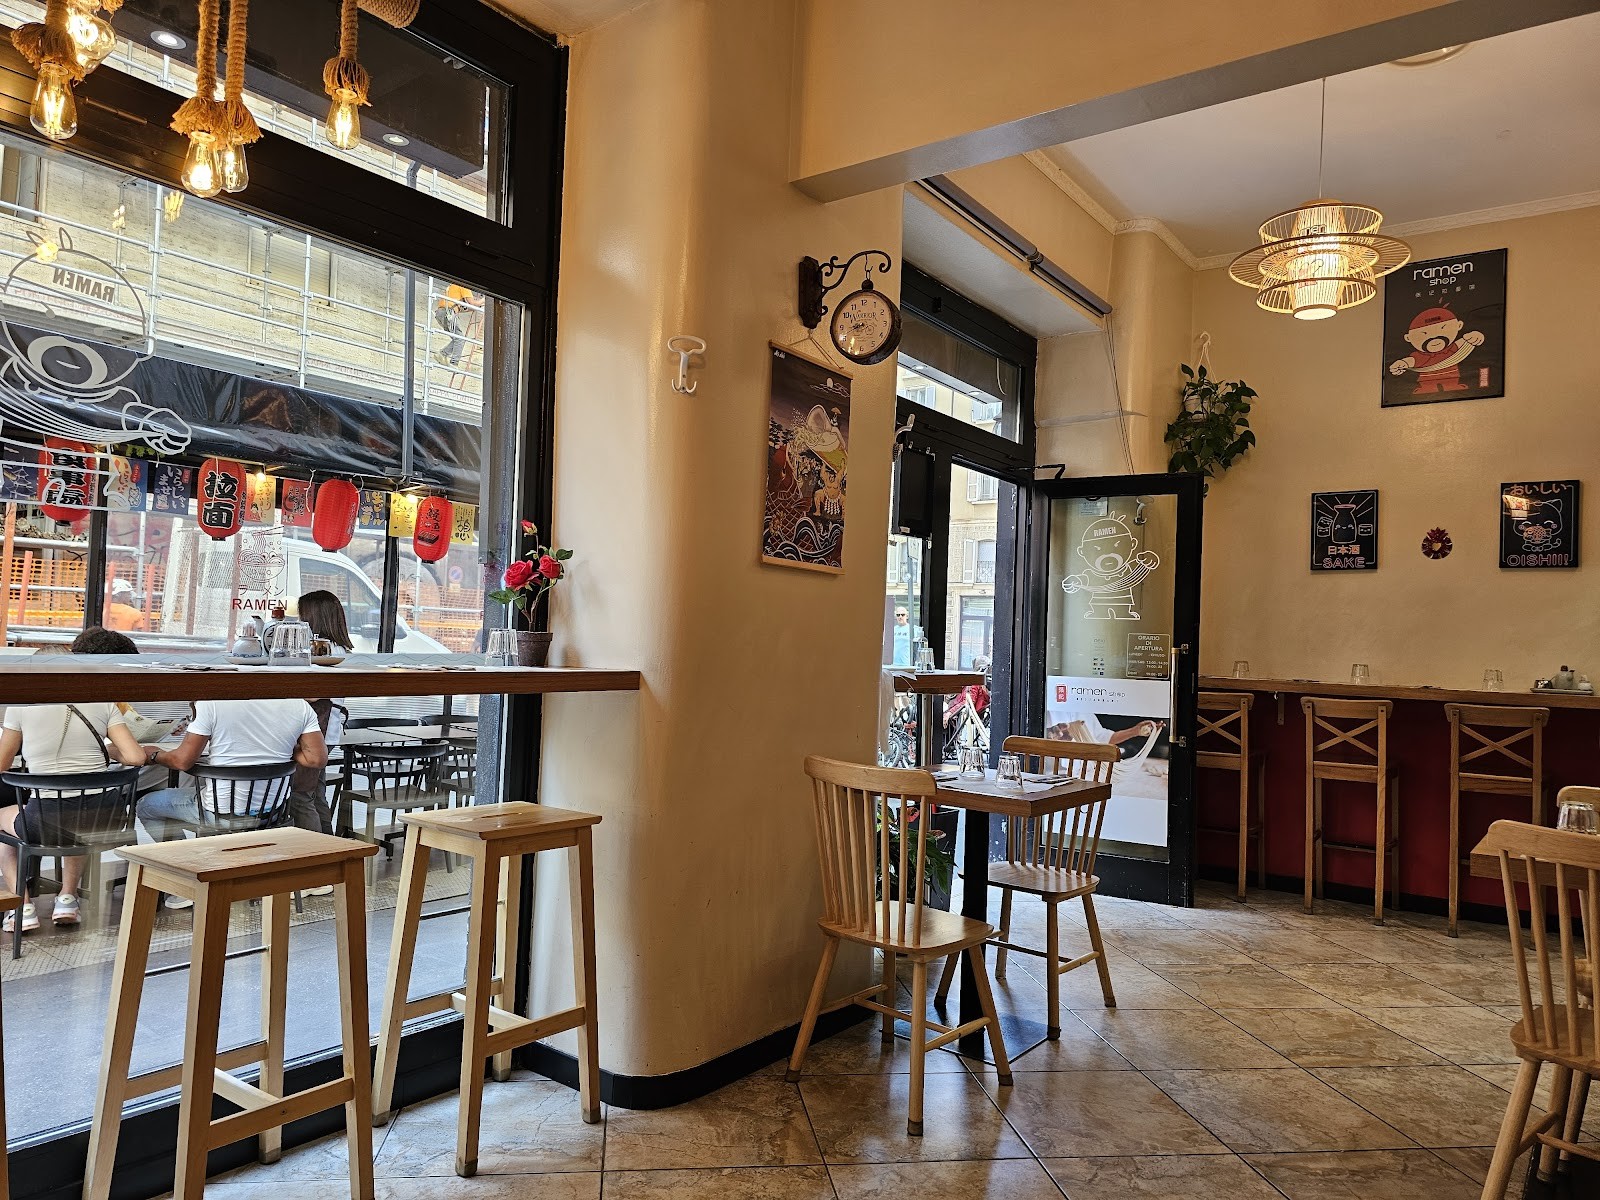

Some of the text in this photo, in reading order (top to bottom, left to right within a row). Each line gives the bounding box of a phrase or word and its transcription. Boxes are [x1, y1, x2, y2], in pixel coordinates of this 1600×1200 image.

[1413, 262, 1473, 280] ramen
[1429, 276, 1457, 286] shop
[1510, 482, 1567, 496] おいしい
[1093, 526, 1117, 537] RAMEN
[1327, 544, 1361, 555] 日本酒
[1322, 556, 1366, 568] SAKE
[232, 598, 288, 611] RAMEN
[1071, 687, 1107, 696] ramen
